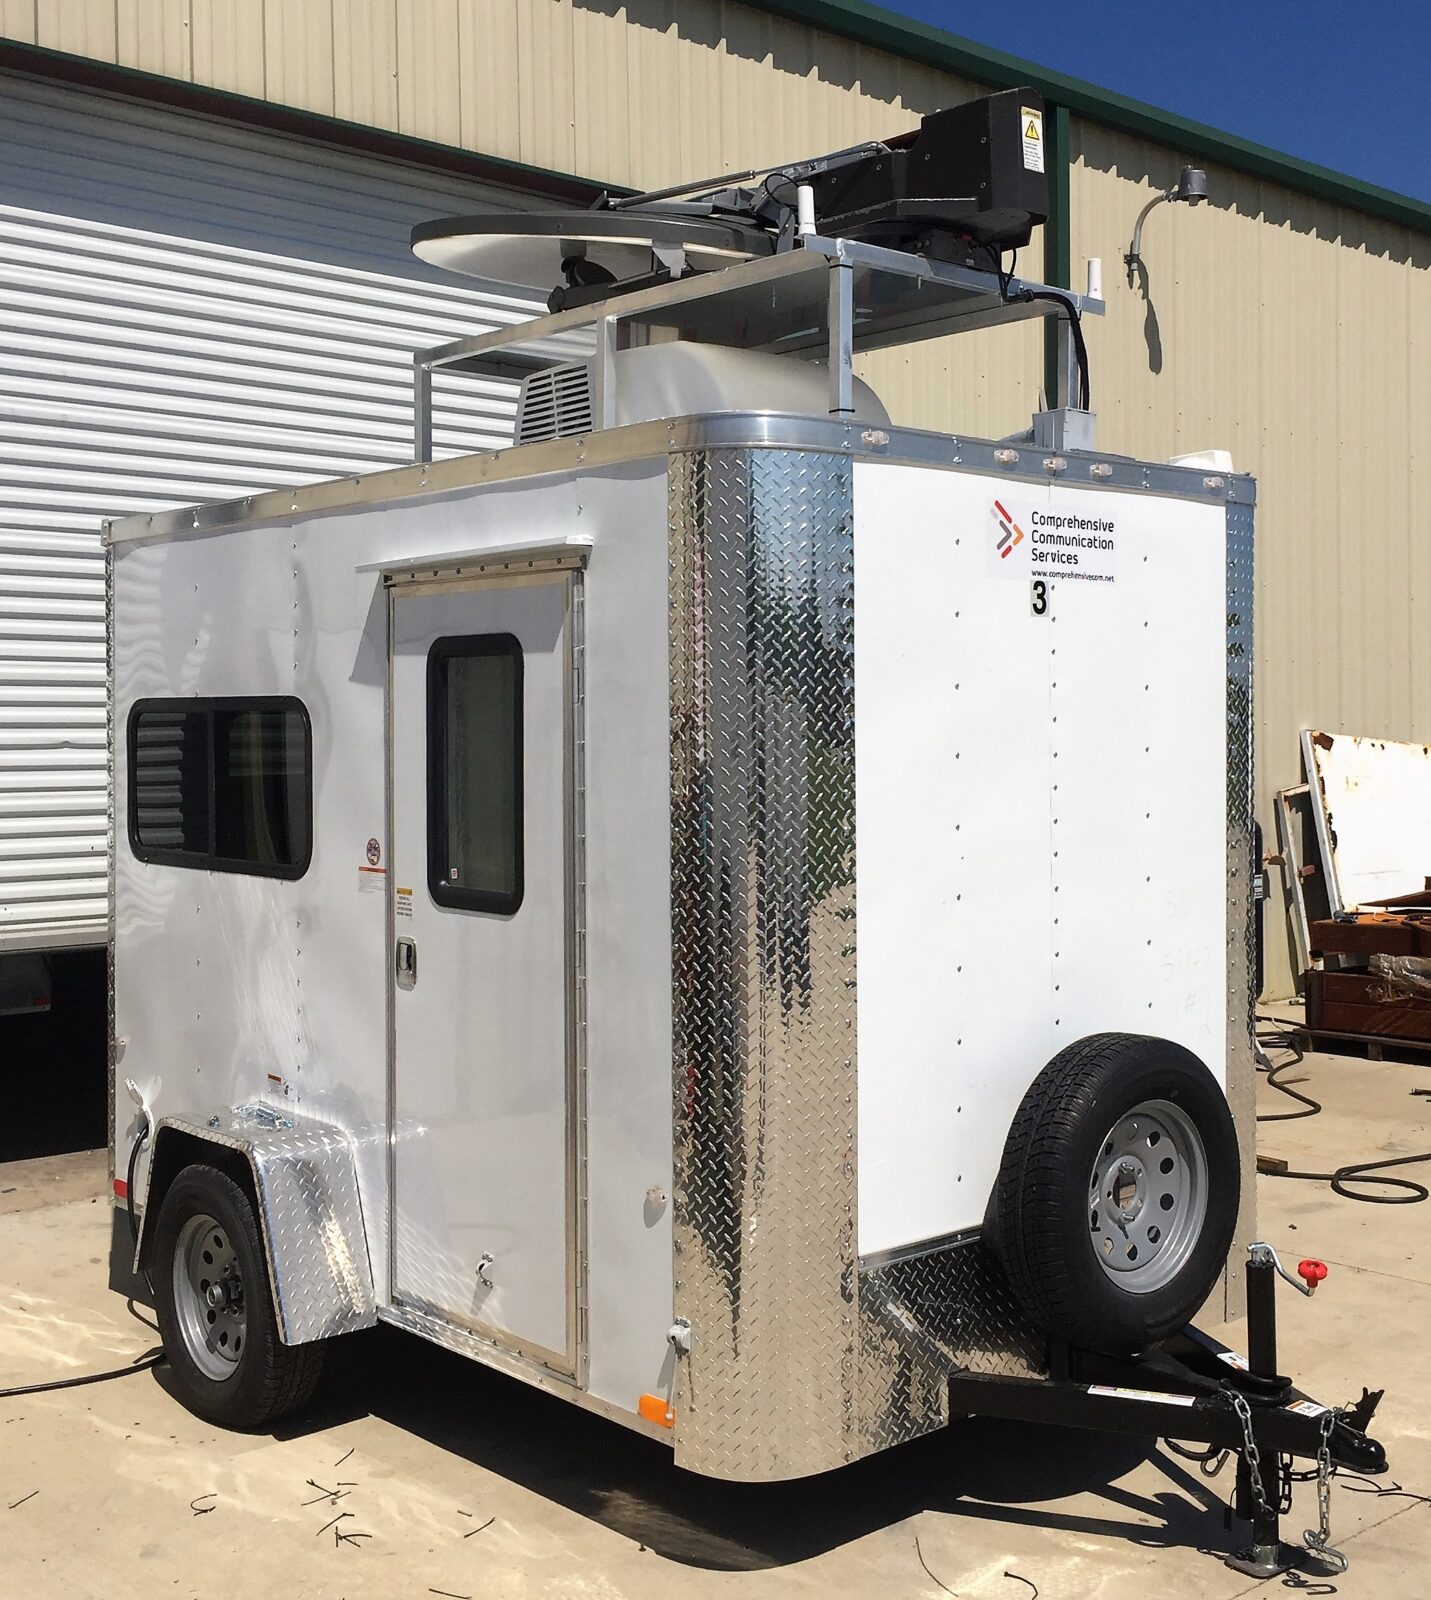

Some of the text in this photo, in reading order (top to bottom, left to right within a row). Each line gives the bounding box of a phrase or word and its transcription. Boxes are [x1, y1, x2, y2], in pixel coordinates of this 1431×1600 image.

[1031, 511, 1115, 532] Comprehensive
[1031, 529, 1114, 550] Communication
[1031, 548, 1079, 565] Services
[1031, 570, 1115, 583] www.comprehensivecom.net
[1032, 580, 1047, 615] 3
